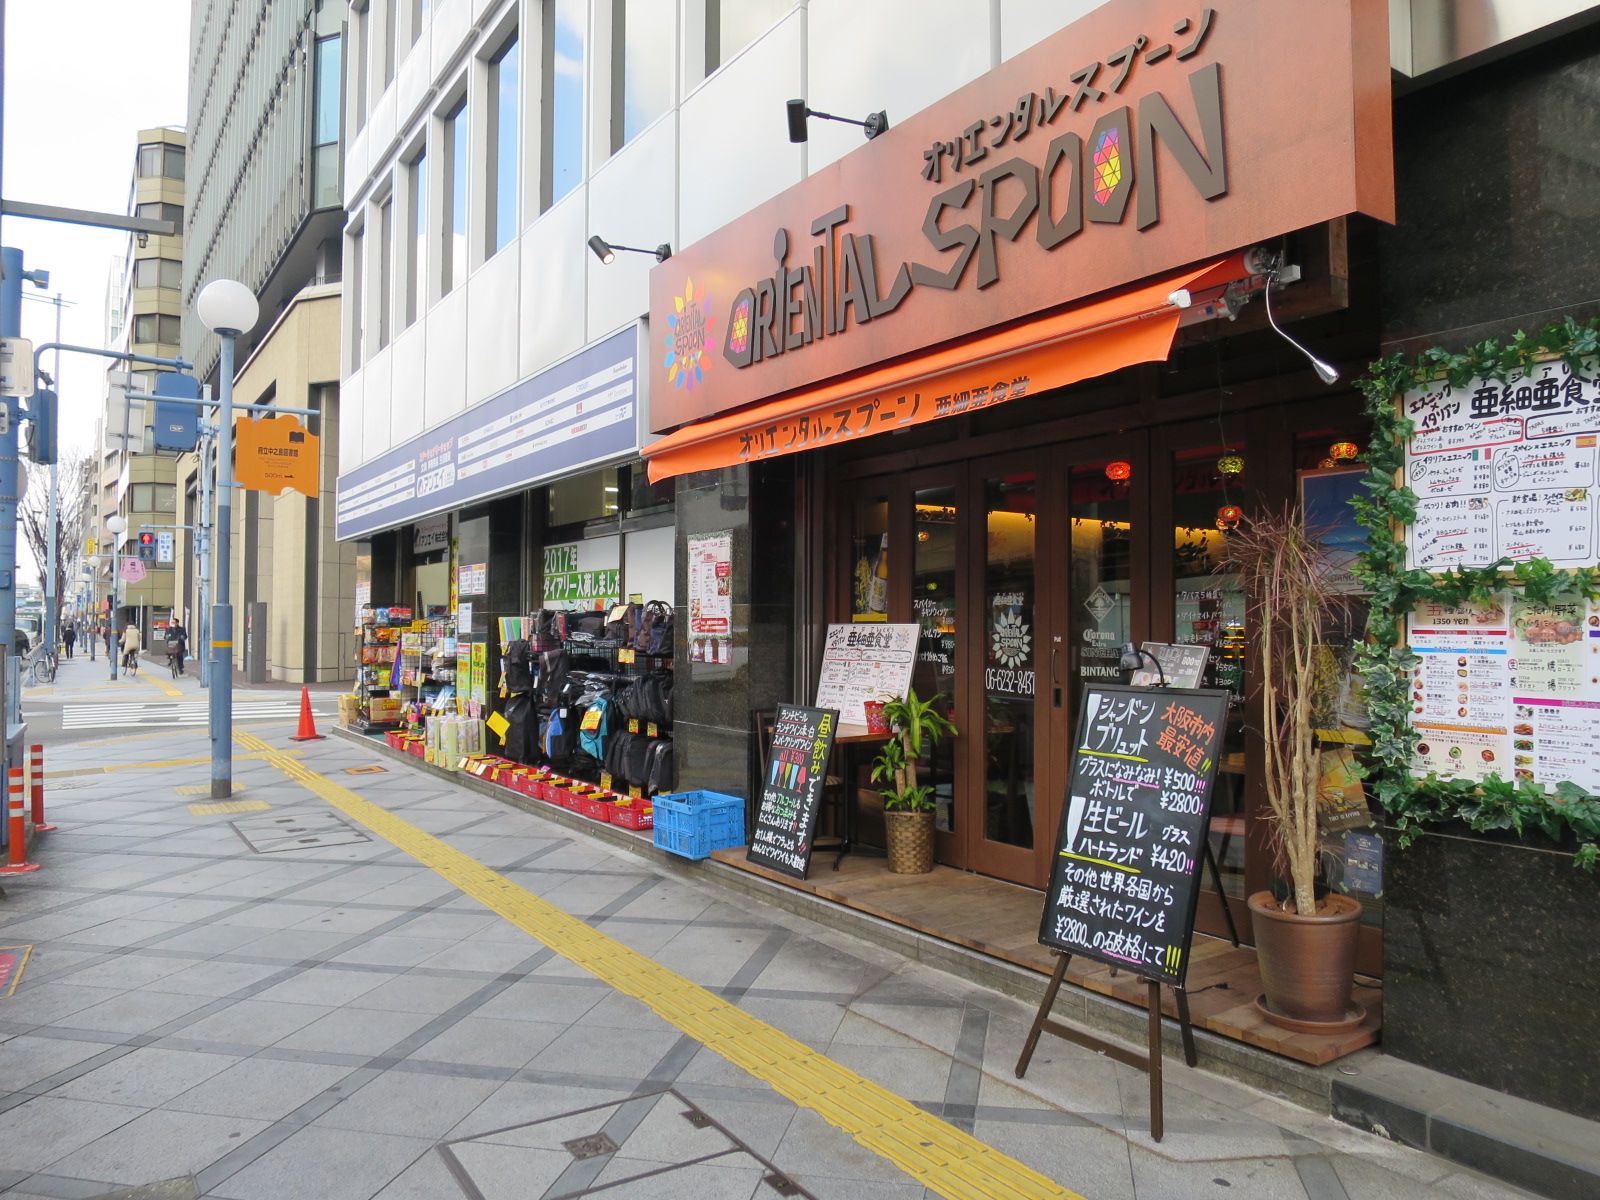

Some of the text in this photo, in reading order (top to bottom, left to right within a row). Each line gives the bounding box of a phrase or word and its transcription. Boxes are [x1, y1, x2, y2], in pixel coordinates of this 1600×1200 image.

[921, 8, 1216, 183] オリエンタルスプーン
[723, 62, 1228, 369] ORIENTAL SPOON
[738, 375, 1031, 458] オリエンタルスプーン 亜細亜食堂
[1470, 374, 1600, 419] 亜細亜食
[544, 546, 577, 574] 2017年
[1083, 628, 1115, 642] Corona
[1080, 666, 1120, 677] BINTANG
[1096, 723, 1149, 755] ブリュット
[1099, 697, 1216, 745] シャンドン 大阪市内
[1089, 778, 1139, 801] ボトルで
[1084, 800, 1191, 845] 生ビール グラス
[1078, 837, 1144, 865] ハートランド
[1056, 884, 1166, 933] 厳選されたワインを
